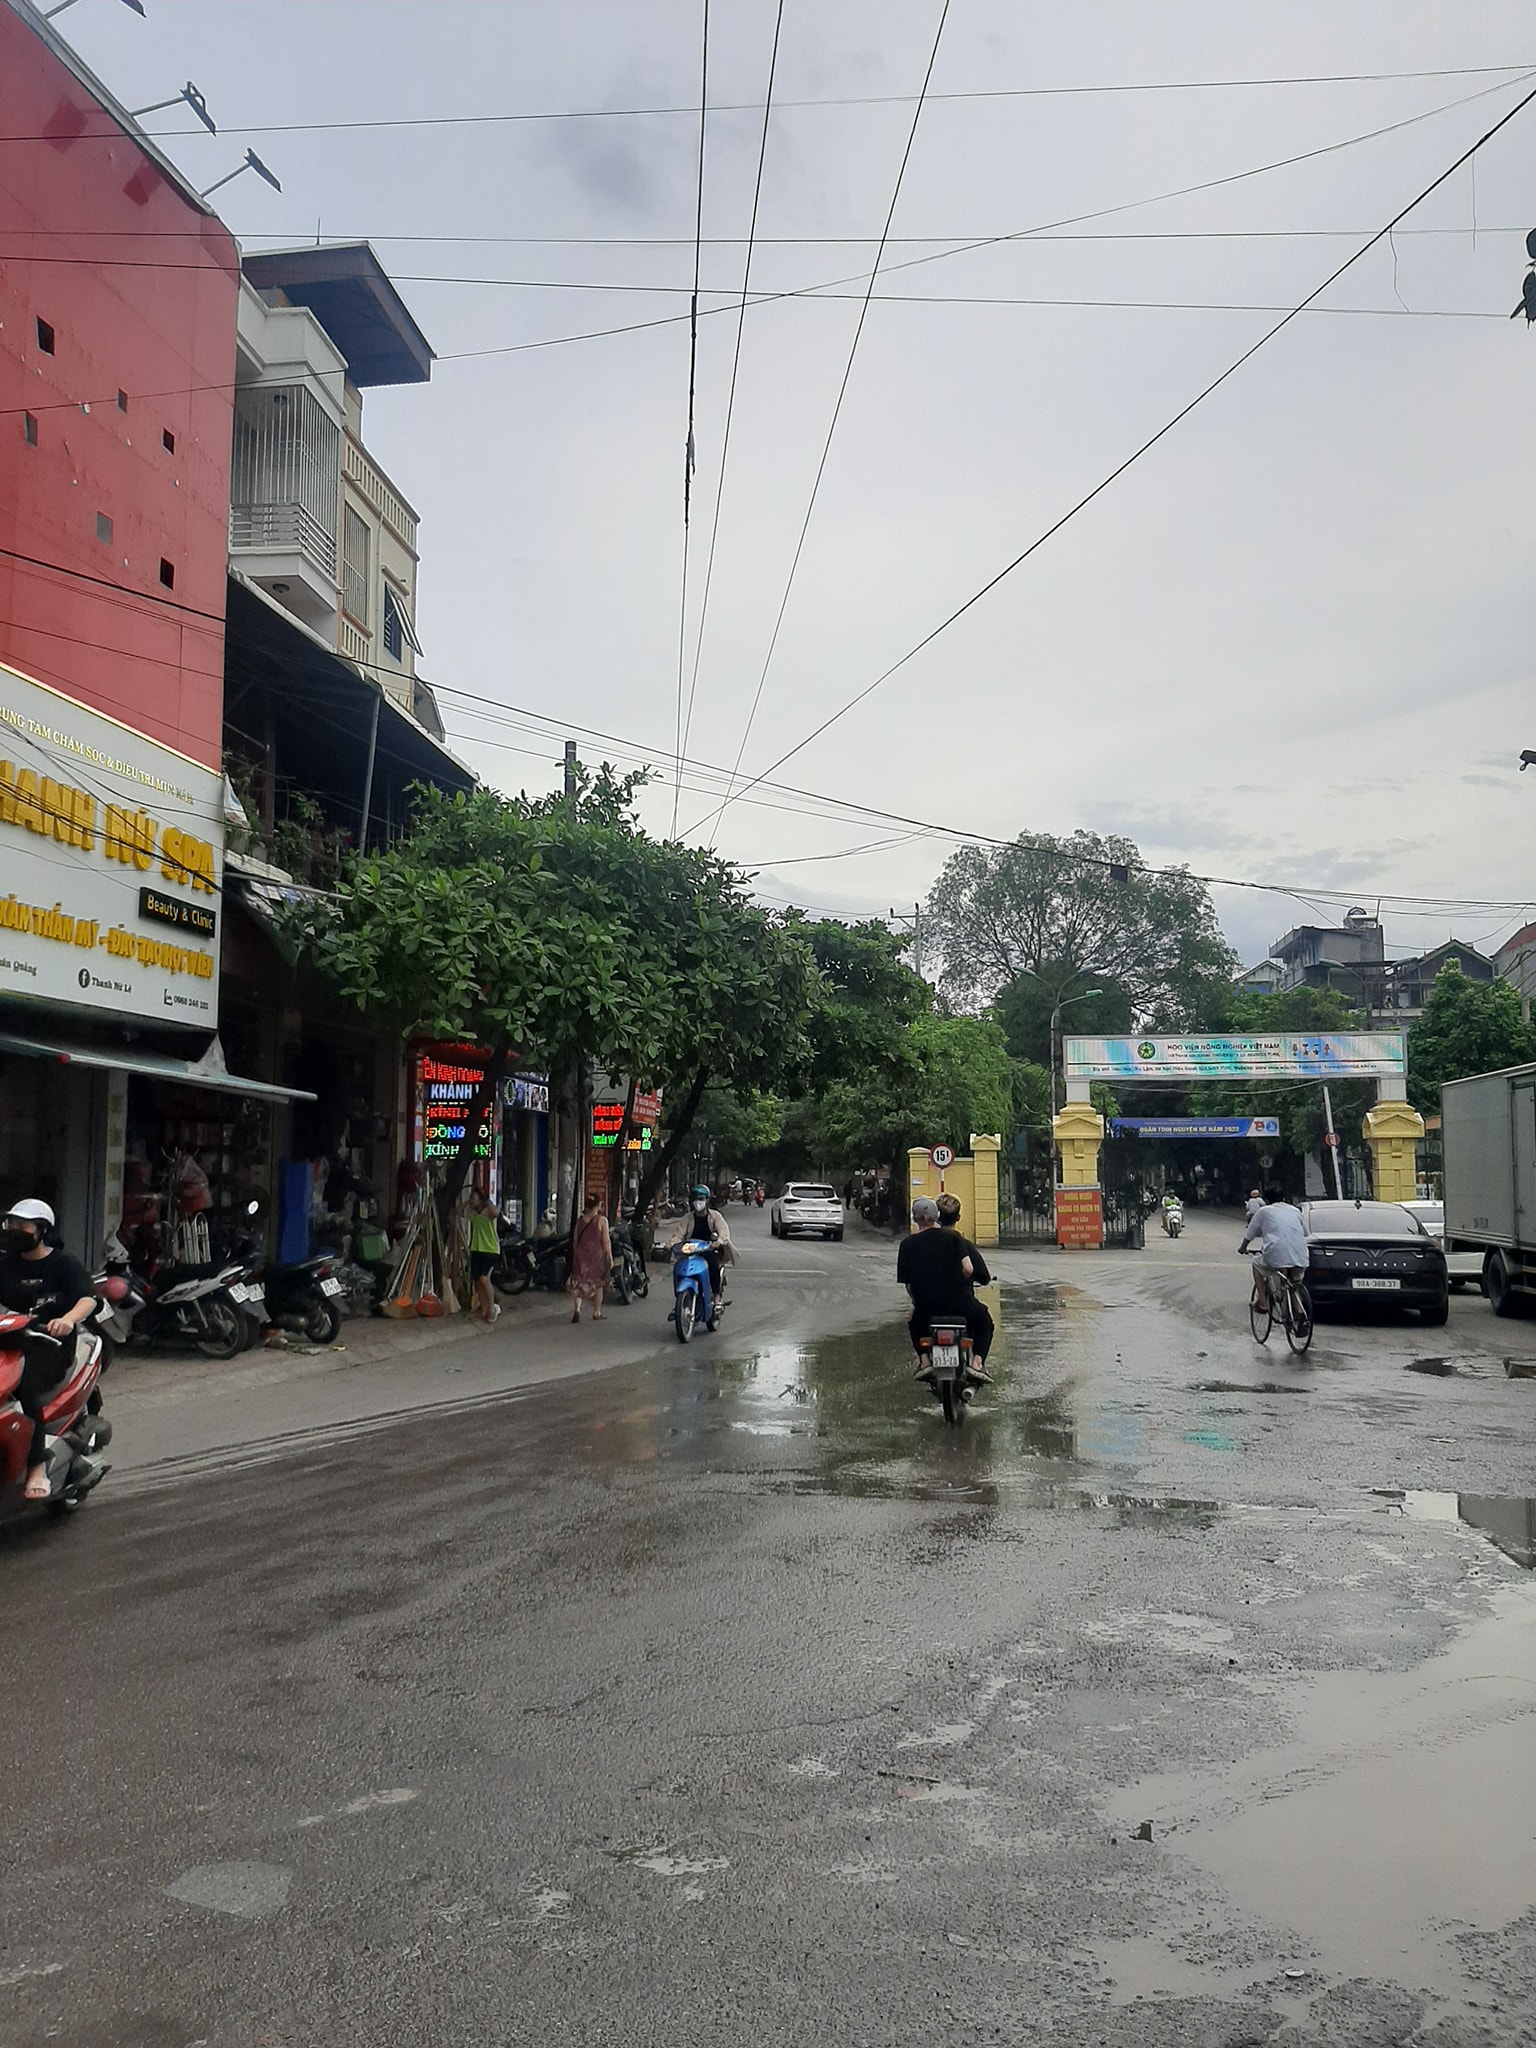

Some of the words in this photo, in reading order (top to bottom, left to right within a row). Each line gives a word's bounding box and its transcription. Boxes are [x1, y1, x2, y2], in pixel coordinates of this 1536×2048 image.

[106, 756, 114, 769] &
[161, 827, 216, 895] SPA
[147, 894, 179, 921] Beauty
[182, 908, 189, 922] &
[191, 909, 213, 930] Clinic
